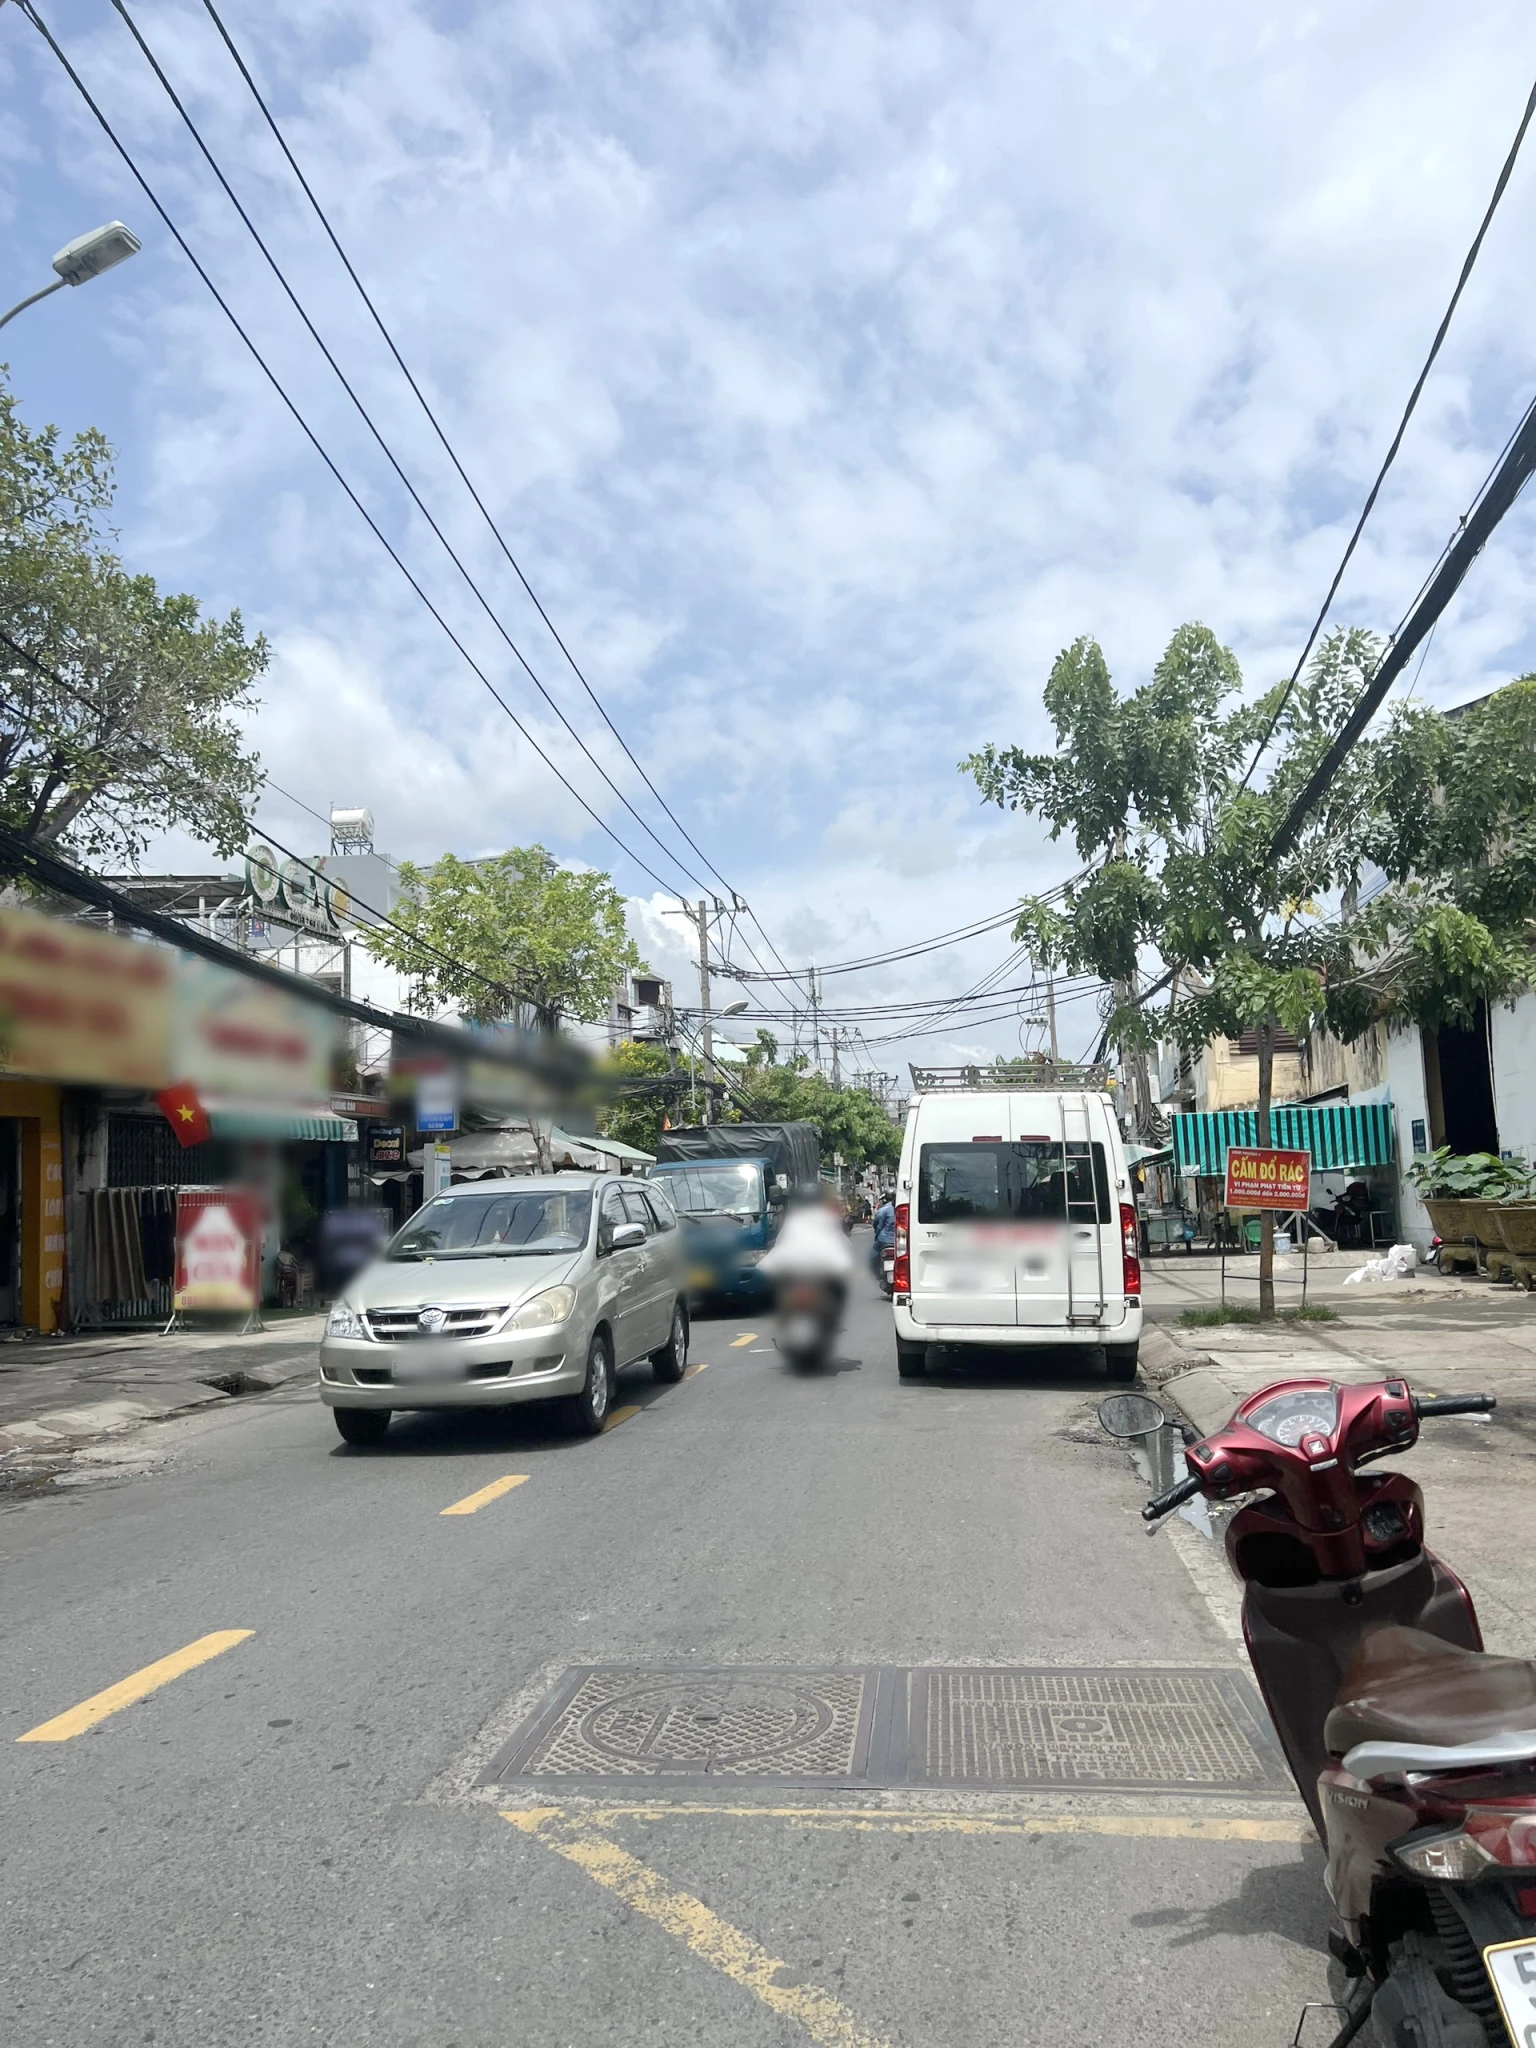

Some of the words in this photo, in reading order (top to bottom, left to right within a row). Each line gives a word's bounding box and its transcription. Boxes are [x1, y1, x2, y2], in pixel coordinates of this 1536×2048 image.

[370, 1148, 400, 1160] Laze
[1231, 1156, 1257, 1180] CẤM
[1260, 1156, 1277, 1180] ĐỔ
[1279, 1160, 1304, 1182] RÁC
[1328, 1789, 1370, 1809] VISION
